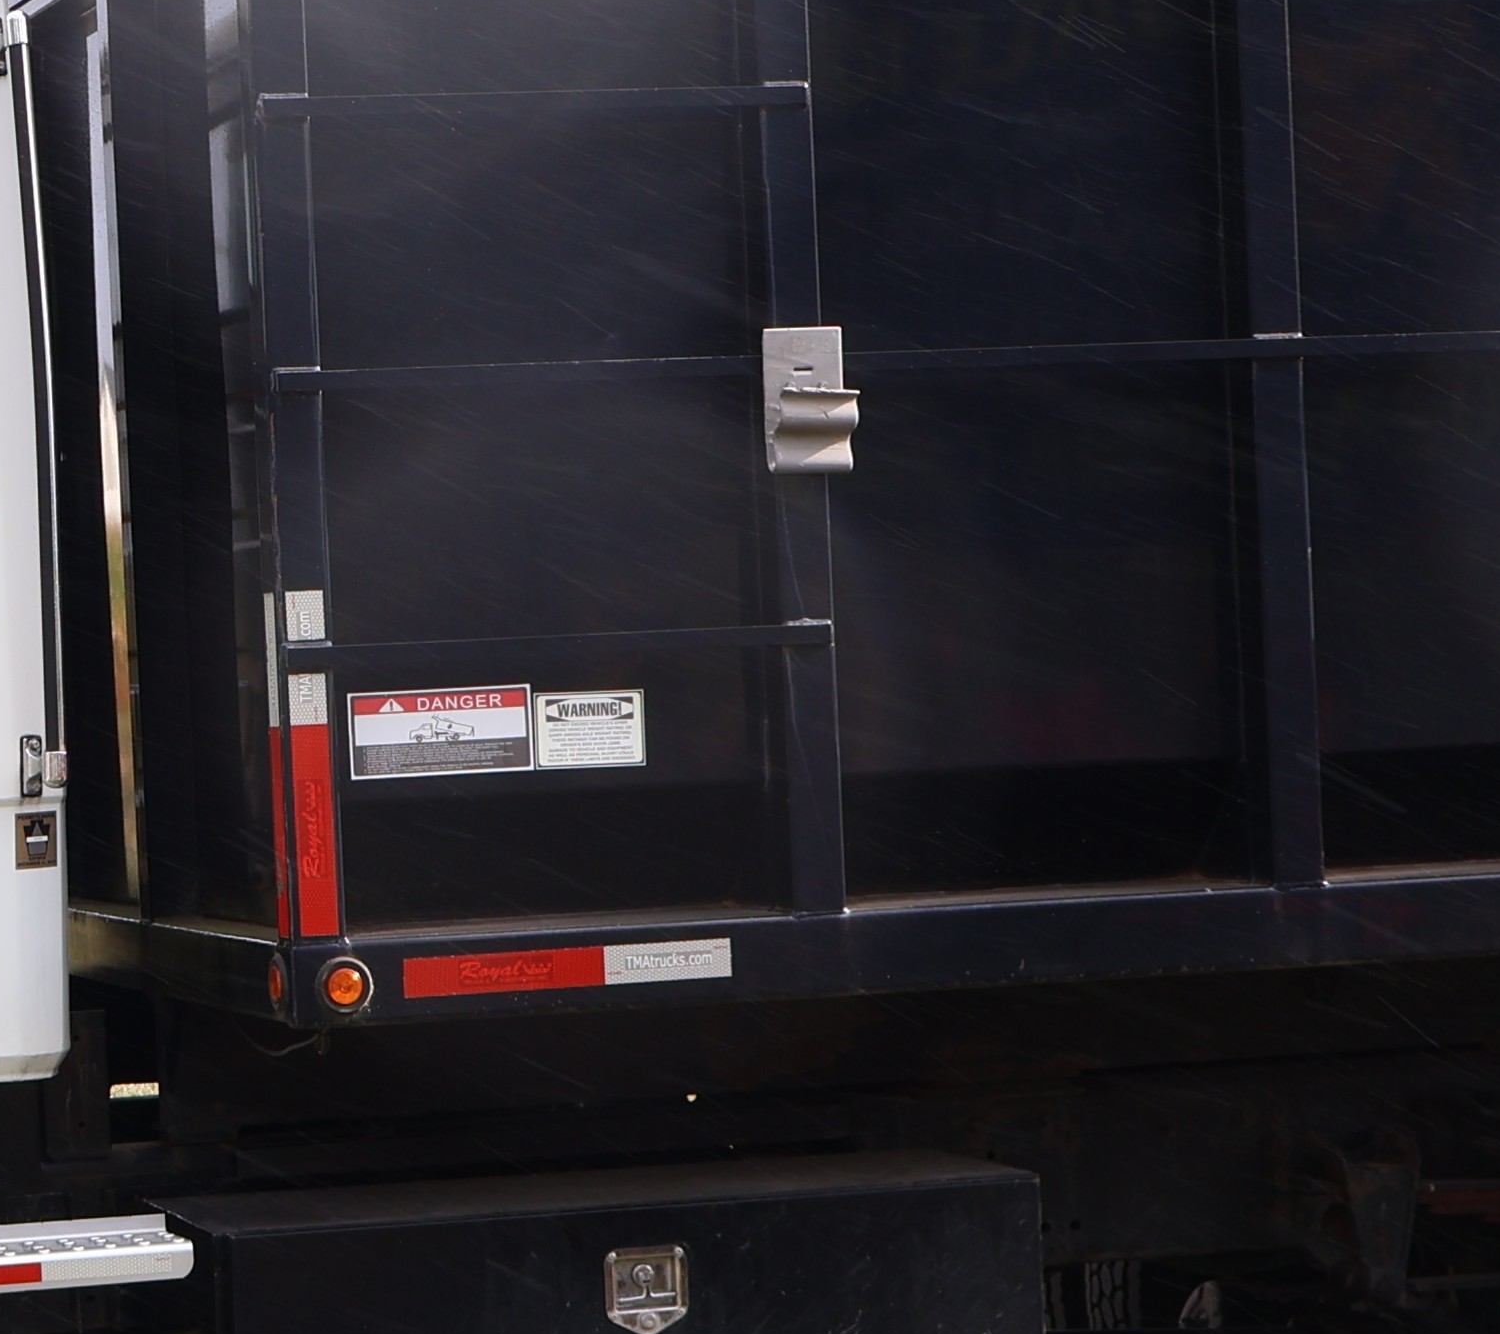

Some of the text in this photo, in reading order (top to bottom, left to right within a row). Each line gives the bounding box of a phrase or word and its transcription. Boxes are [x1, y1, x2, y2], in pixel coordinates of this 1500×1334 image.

[416, 693, 503, 711] DANGER
[556, 701, 623, 718] WARNING!
[624, 952, 713, 971] TMAtrucks.com
[459, 960, 523, 982] Royal
